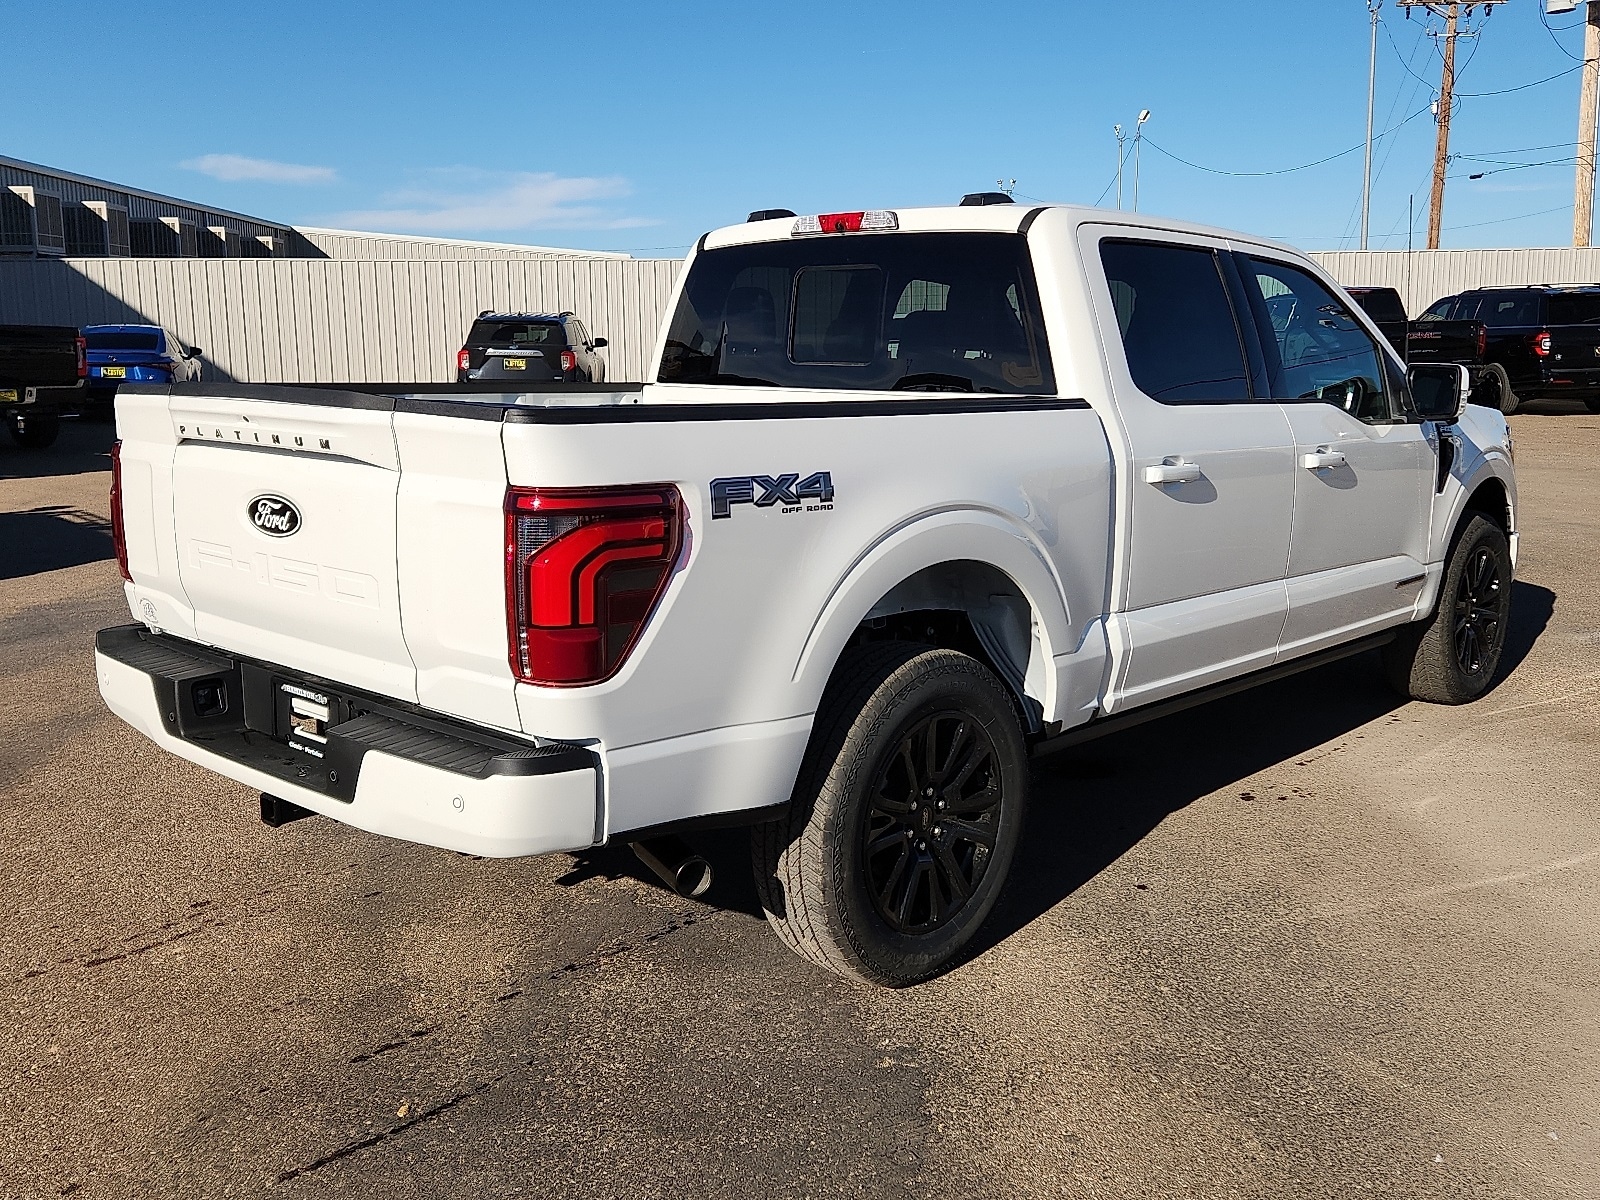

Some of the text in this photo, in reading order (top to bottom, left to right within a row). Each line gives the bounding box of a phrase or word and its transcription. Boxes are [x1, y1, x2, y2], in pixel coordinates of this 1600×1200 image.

[179, 425, 331, 450] PLATINUM
[709, 471, 834, 520] FX4
[806, 504, 834, 512] ROAD
[254, 499, 291, 531] Ford
[188, 538, 380, 610] F-150
